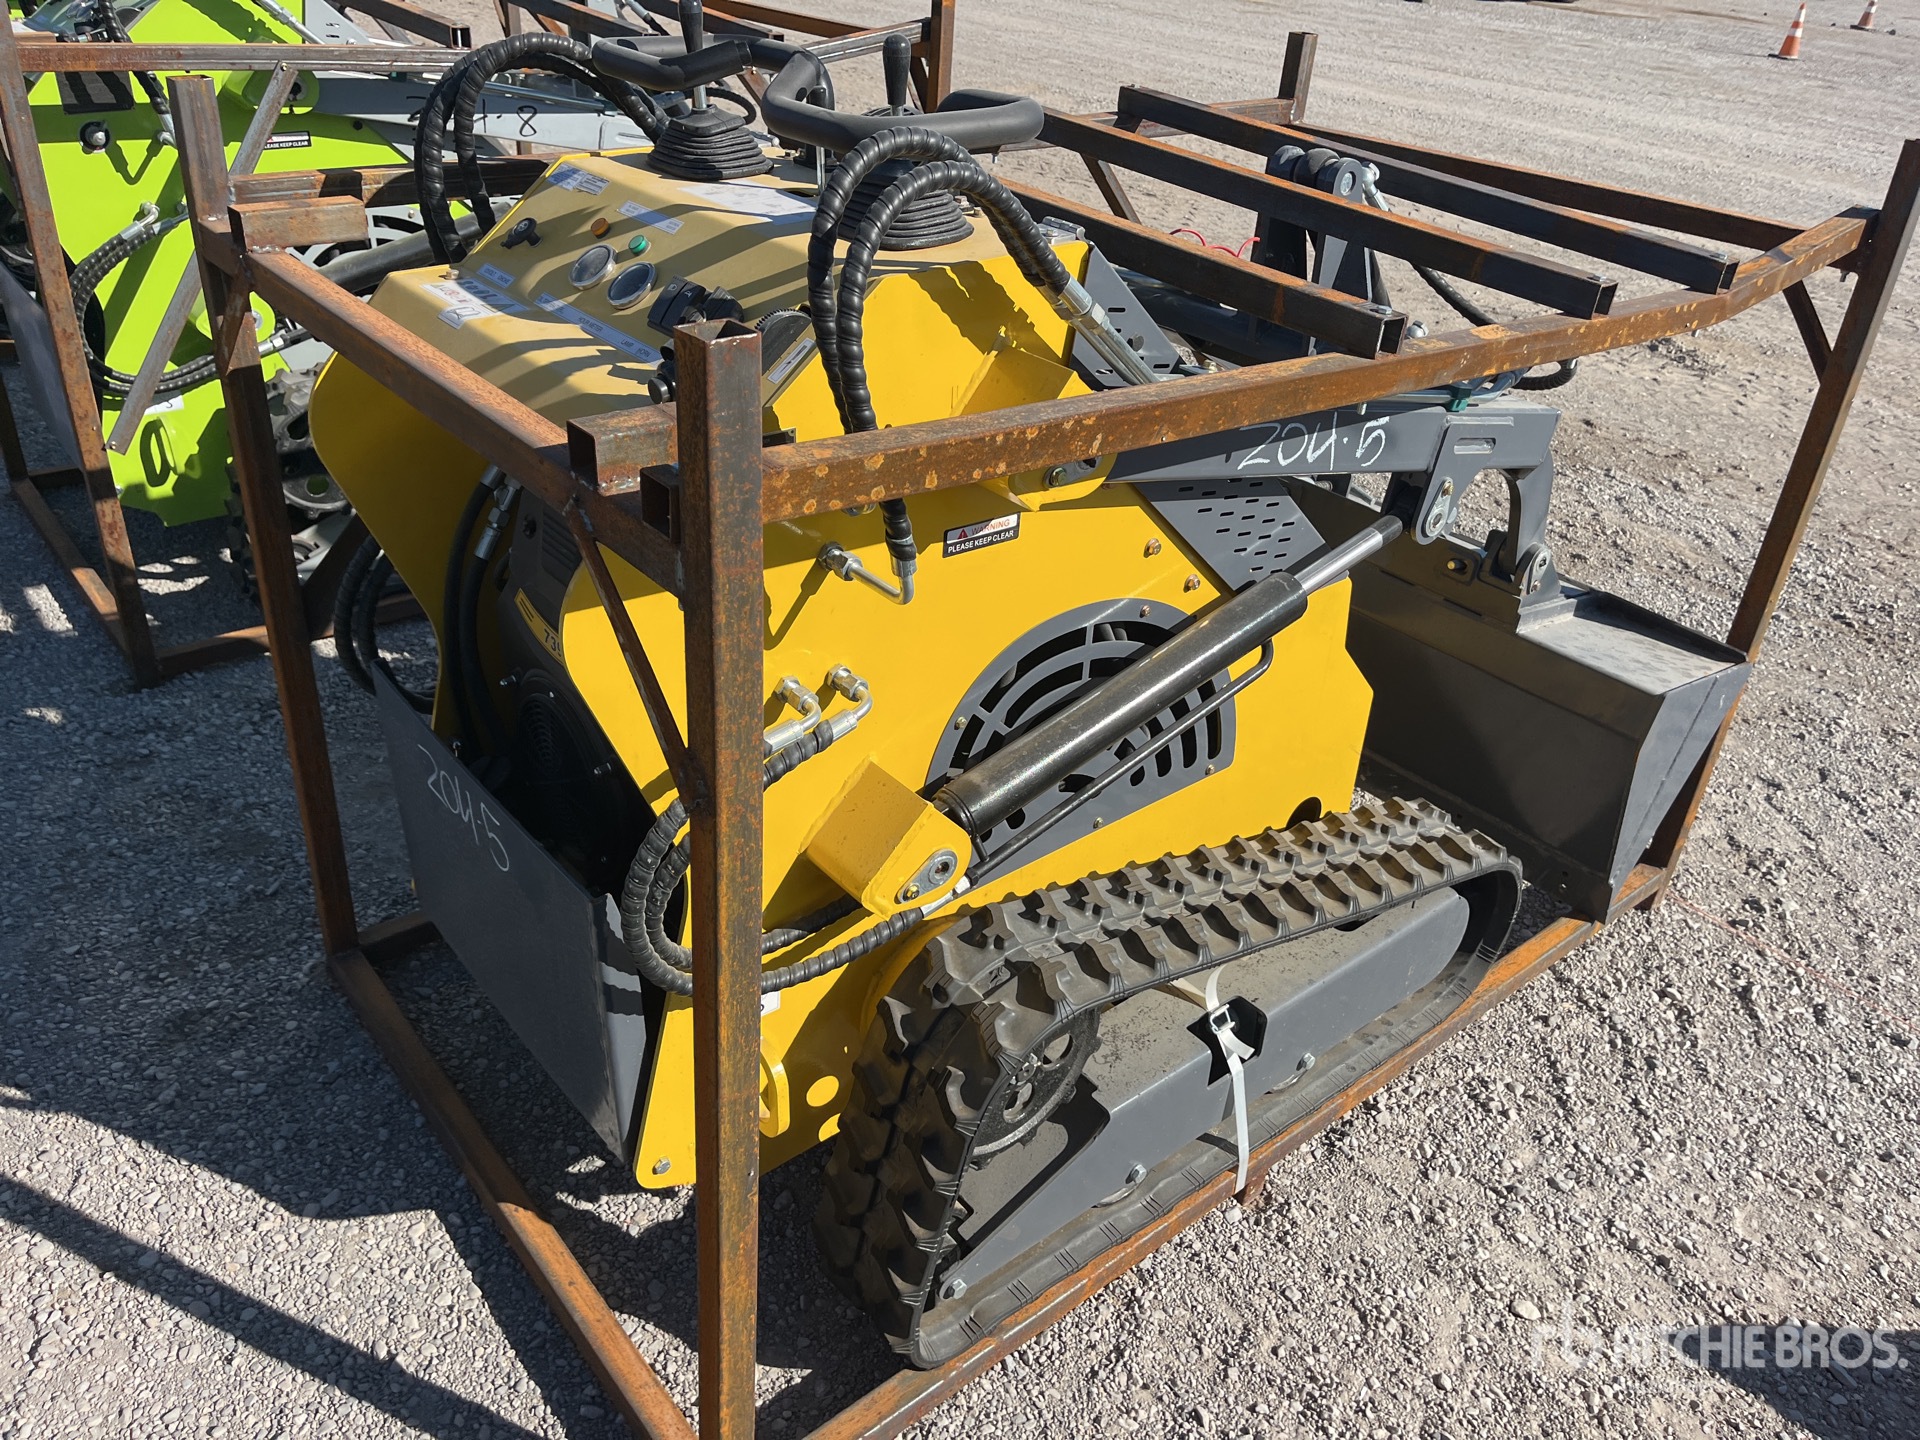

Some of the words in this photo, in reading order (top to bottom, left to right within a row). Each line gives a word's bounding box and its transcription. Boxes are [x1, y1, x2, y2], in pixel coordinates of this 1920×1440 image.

[971, 518, 1010, 536] WARNING
[947, 540, 974, 554] PLEASE
[974, 535, 993, 547] KEEP
[992, 529, 1014, 542] CLEAR
